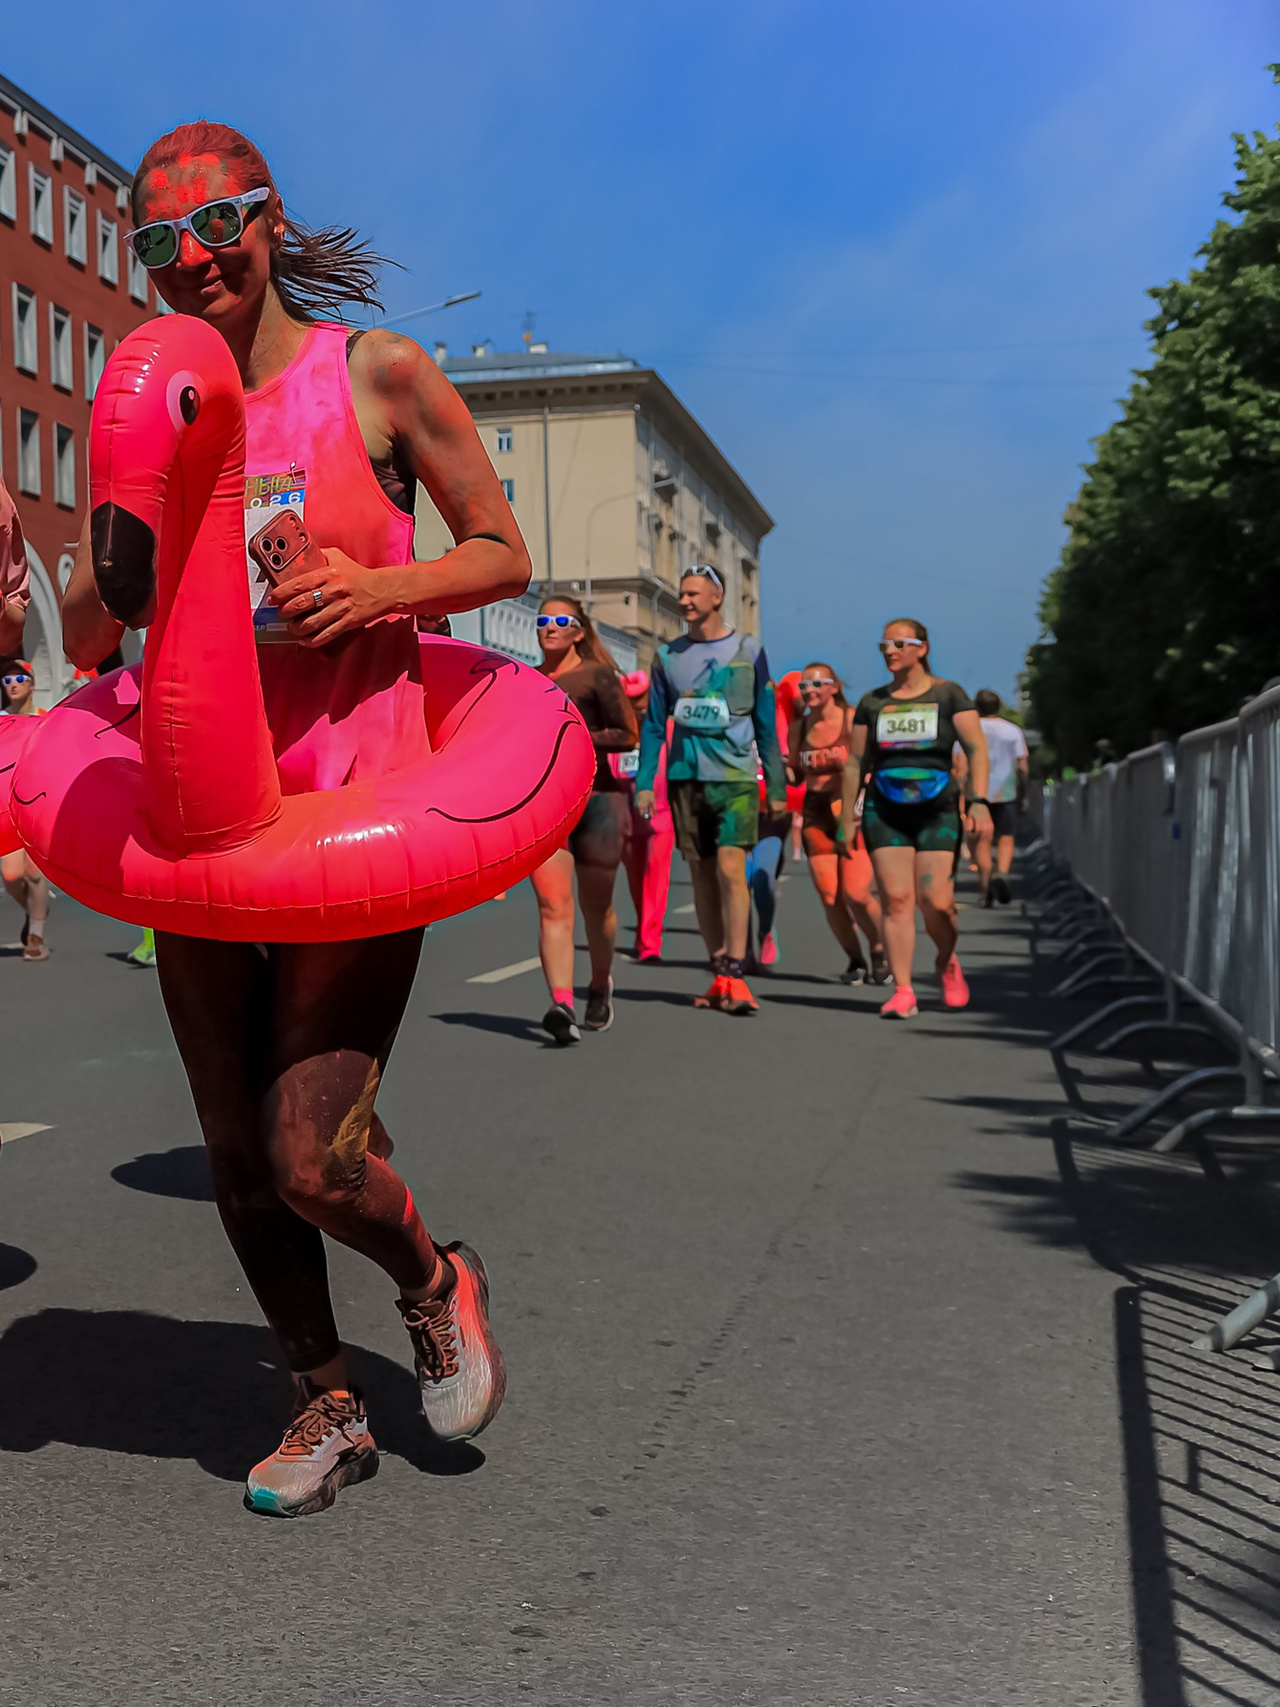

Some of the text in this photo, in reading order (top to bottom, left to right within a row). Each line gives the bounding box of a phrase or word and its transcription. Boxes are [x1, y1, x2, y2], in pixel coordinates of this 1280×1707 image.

[249, 492, 301, 509] 026
[683, 705, 721, 720] 3479
[886, 718, 927, 734] 3481
